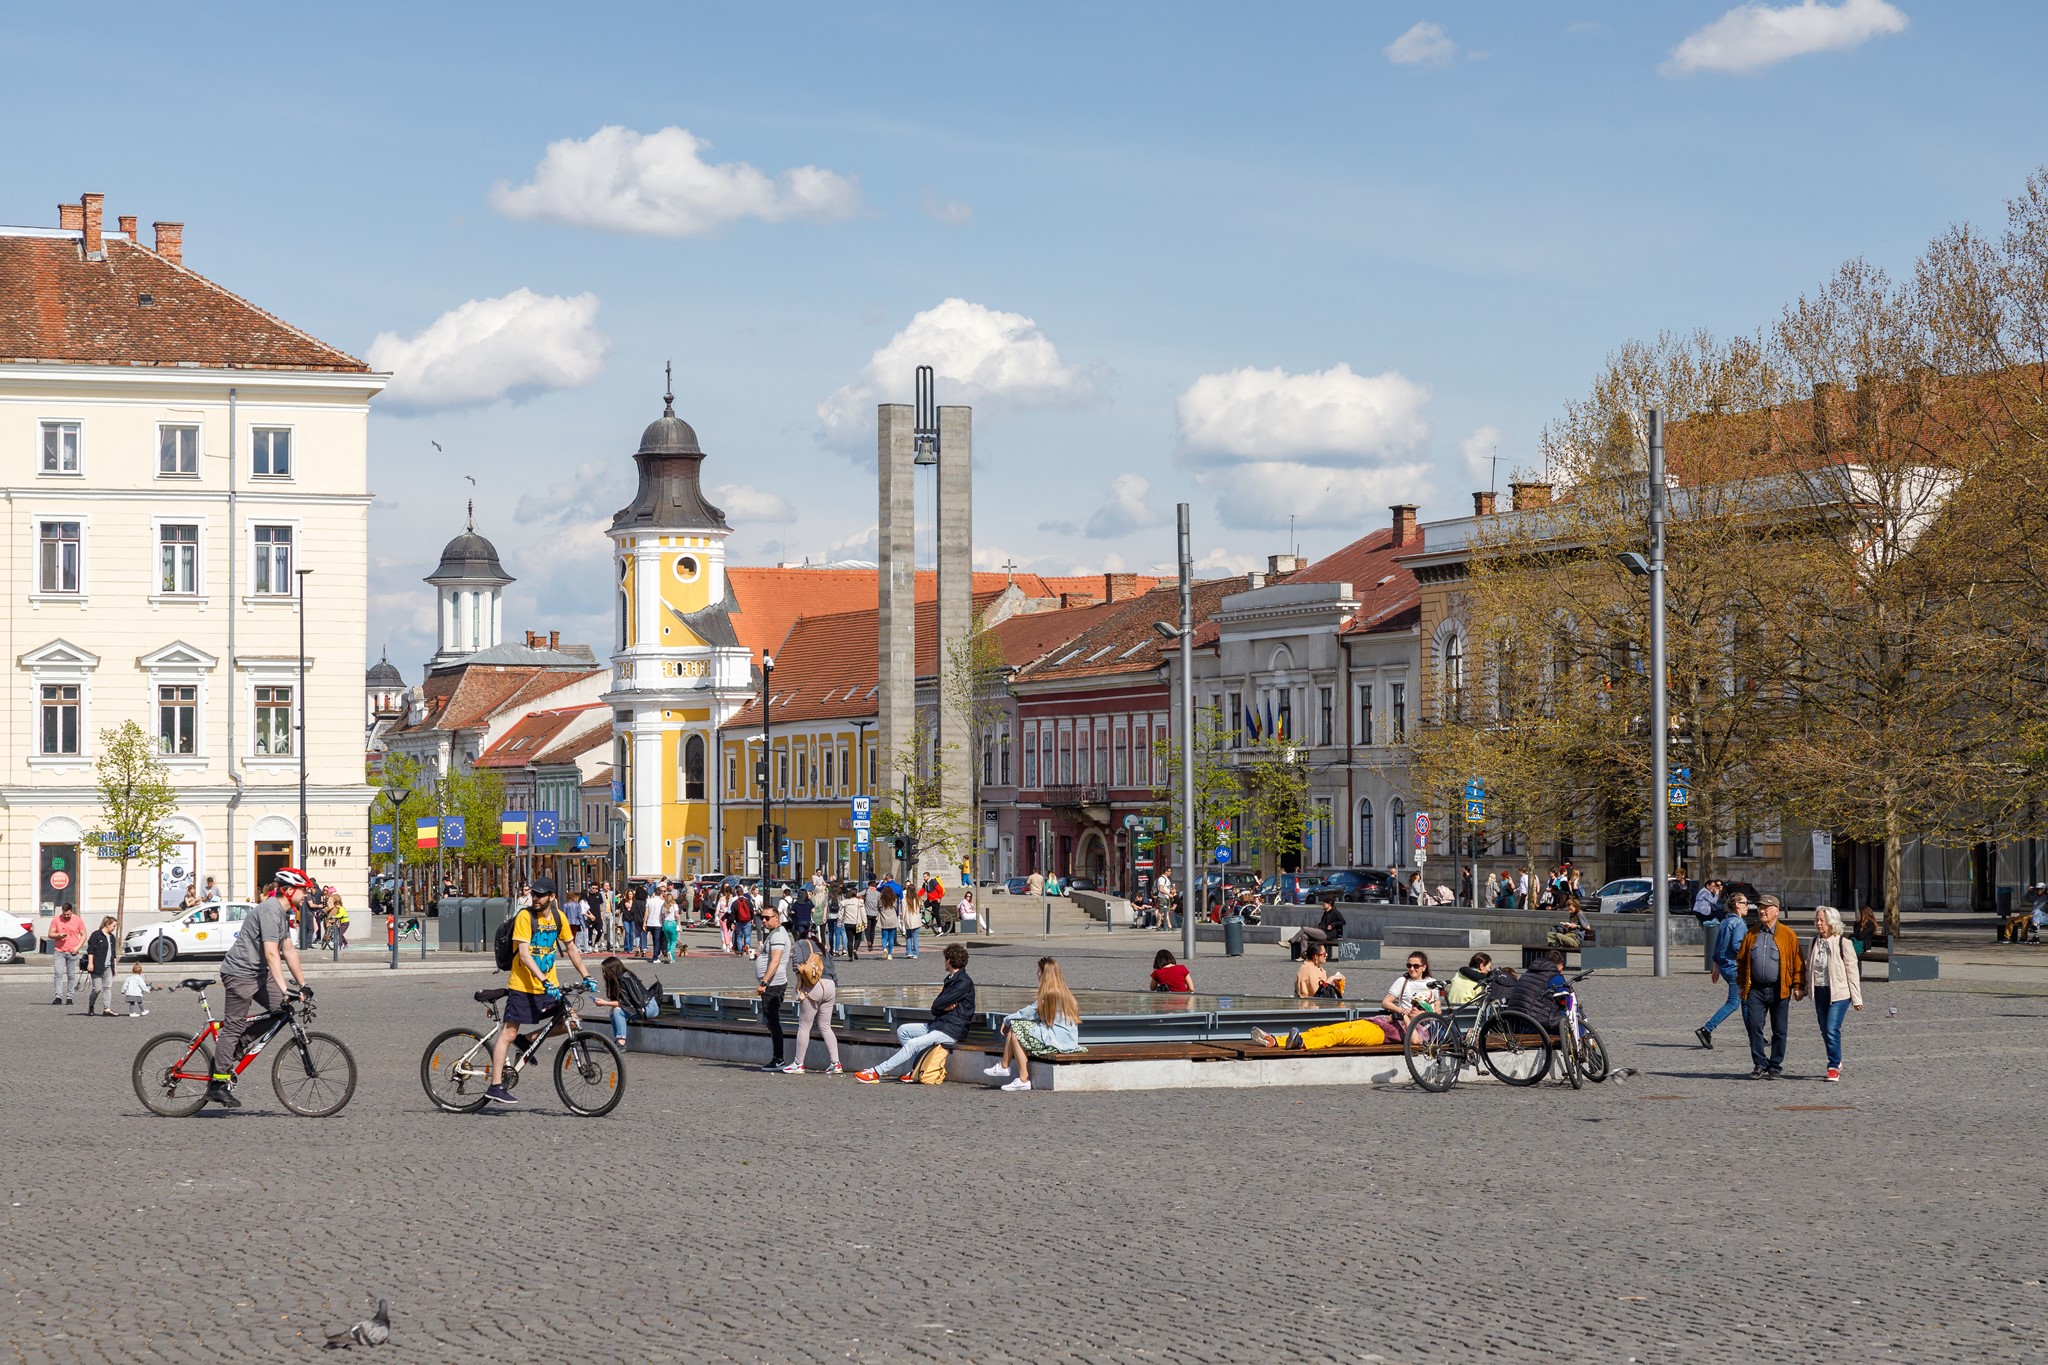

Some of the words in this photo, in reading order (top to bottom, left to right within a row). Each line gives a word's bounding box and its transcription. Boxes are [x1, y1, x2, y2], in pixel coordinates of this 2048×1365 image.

[856, 801, 868, 810] WC
[309, 845, 352, 857] MORITZ
[323, 858, 337, 867] EIS
